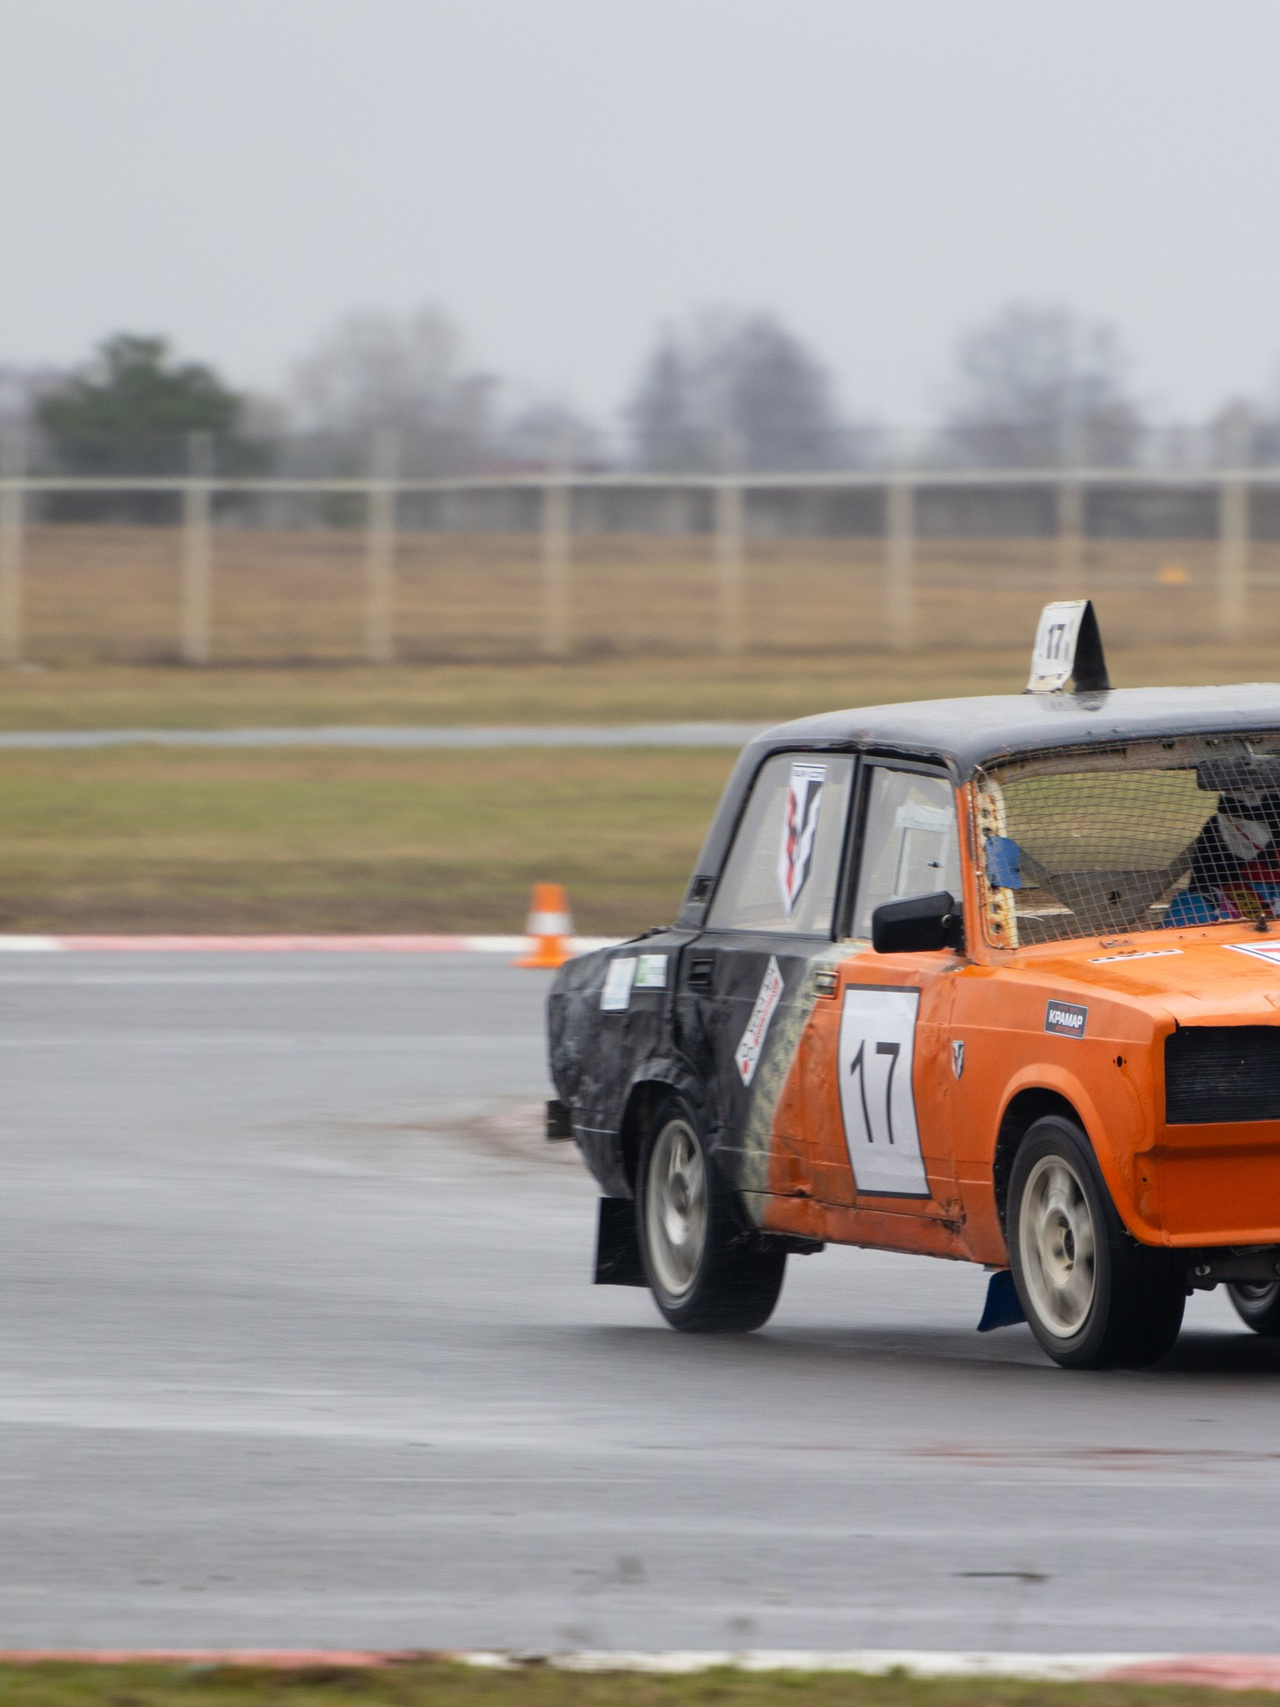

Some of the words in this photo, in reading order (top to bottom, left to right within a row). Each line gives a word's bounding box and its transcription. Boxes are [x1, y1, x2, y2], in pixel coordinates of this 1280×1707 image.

[1046, 623, 1067, 660] 17
[1048, 1009, 1084, 1029] КРАМАР
[850, 1039, 901, 1145] 17
